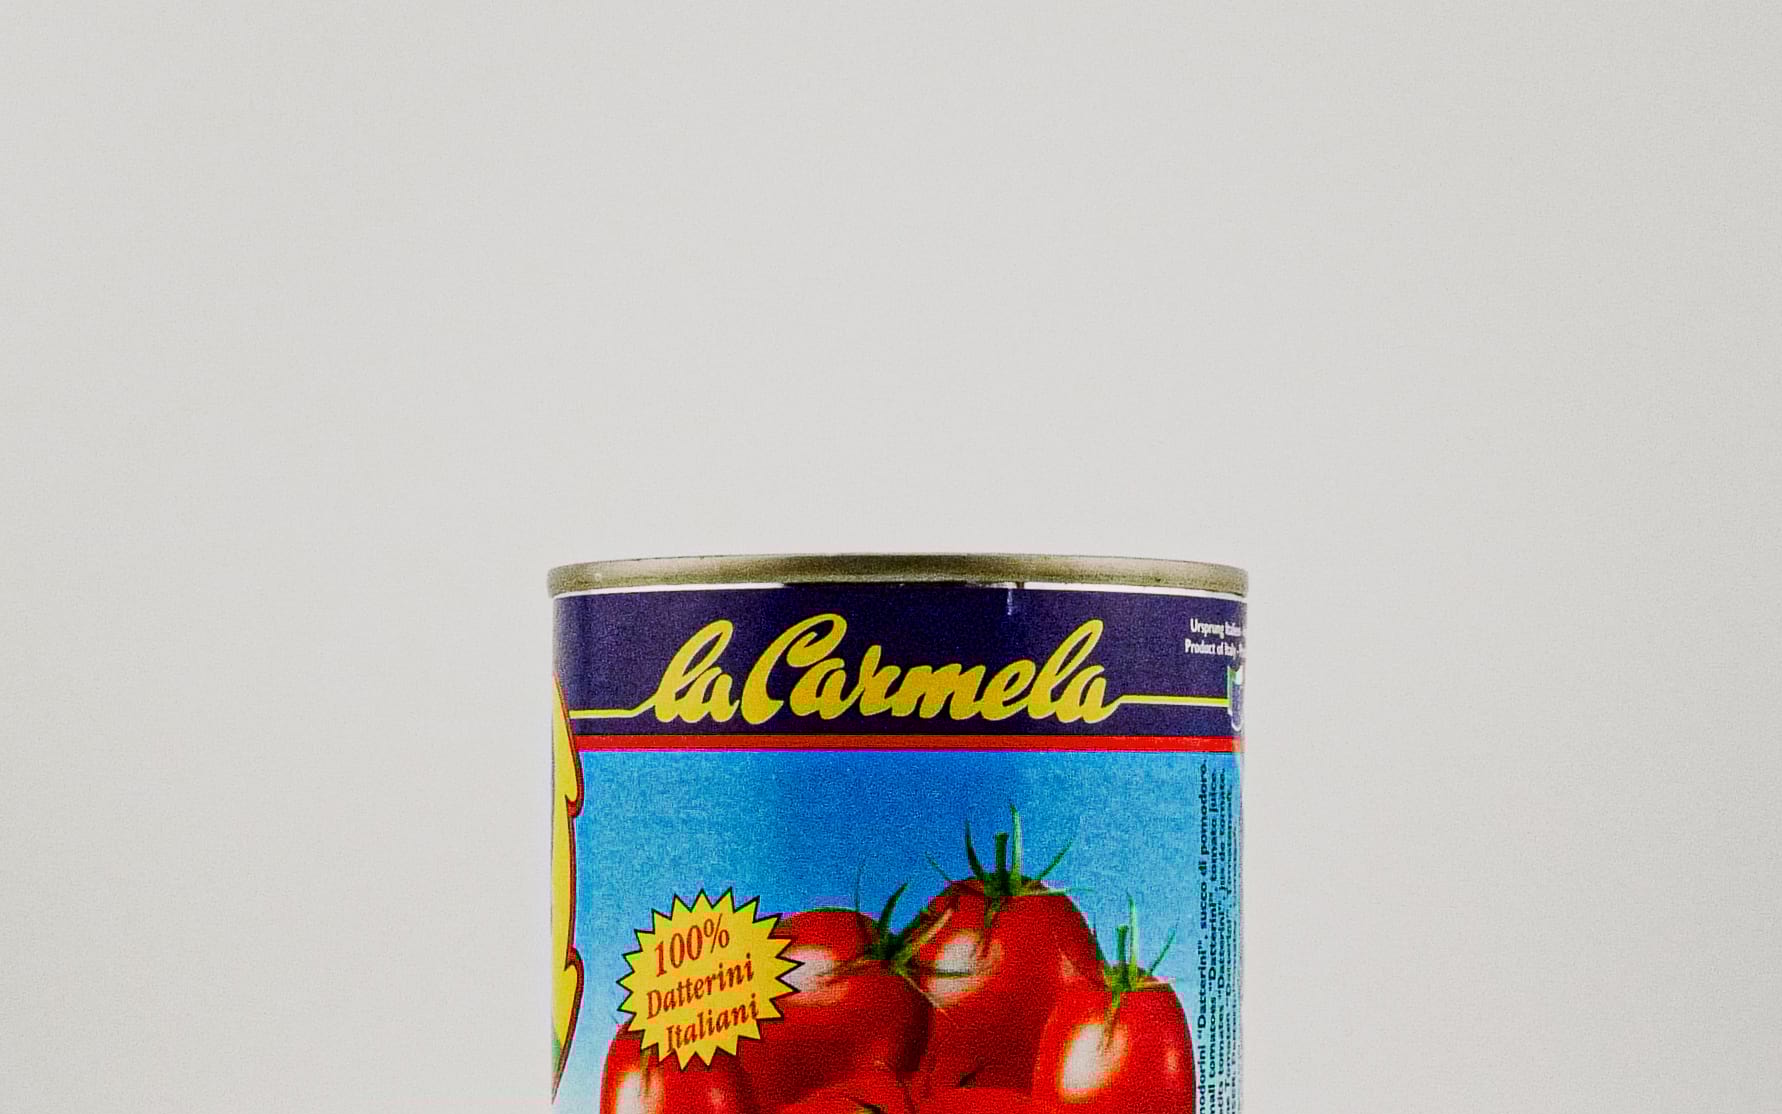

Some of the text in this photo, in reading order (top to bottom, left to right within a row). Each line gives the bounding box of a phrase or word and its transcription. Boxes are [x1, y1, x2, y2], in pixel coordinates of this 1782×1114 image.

[1184, 638, 1216, 655] Product
[1216, 641, 1224, 656] of
[1190, 617, 1225, 640] Ursprung
[642, 612, 1117, 724] la Carmela
[1198, 759, 1209, 856] pomodoro.
[1198, 860, 1207, 876] di
[1218, 842, 1226, 862] de
[1199, 881, 1207, 930] succo
[655, 913, 730, 978] 100%
[646, 952, 754, 1020] Datterini
[665, 993, 760, 1053] Italiani
